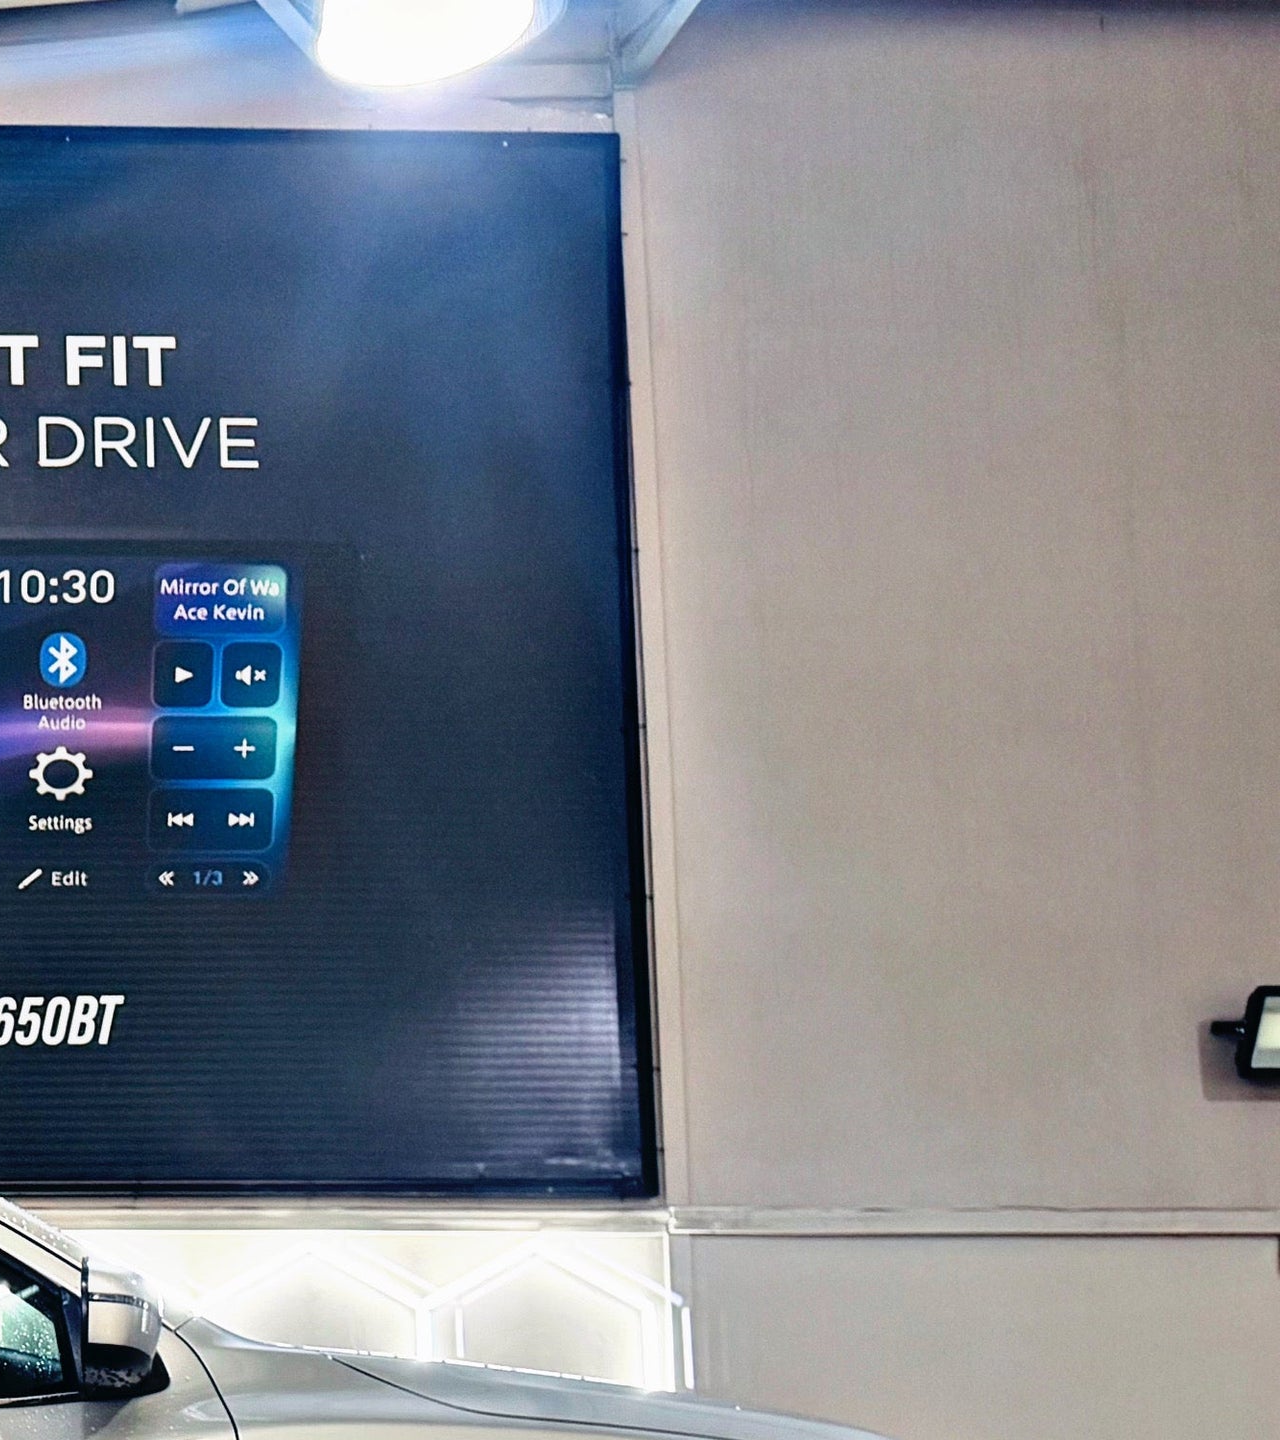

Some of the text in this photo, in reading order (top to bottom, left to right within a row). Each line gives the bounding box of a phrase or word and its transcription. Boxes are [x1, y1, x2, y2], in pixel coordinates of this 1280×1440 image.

[64, 335, 176, 387] FIT
[38, 416, 260, 469] DRIVE
[160, 577, 280, 597] Mirror Of Wa
[173, 602, 265, 621] Ace Kevin
[23, 693, 102, 711] Bluetooth
[38, 716, 86, 731] Audio
[28, 814, 93, 835] Settings
[51, 870, 88, 887] Edit
[193, 870, 223, 886] 1/3
